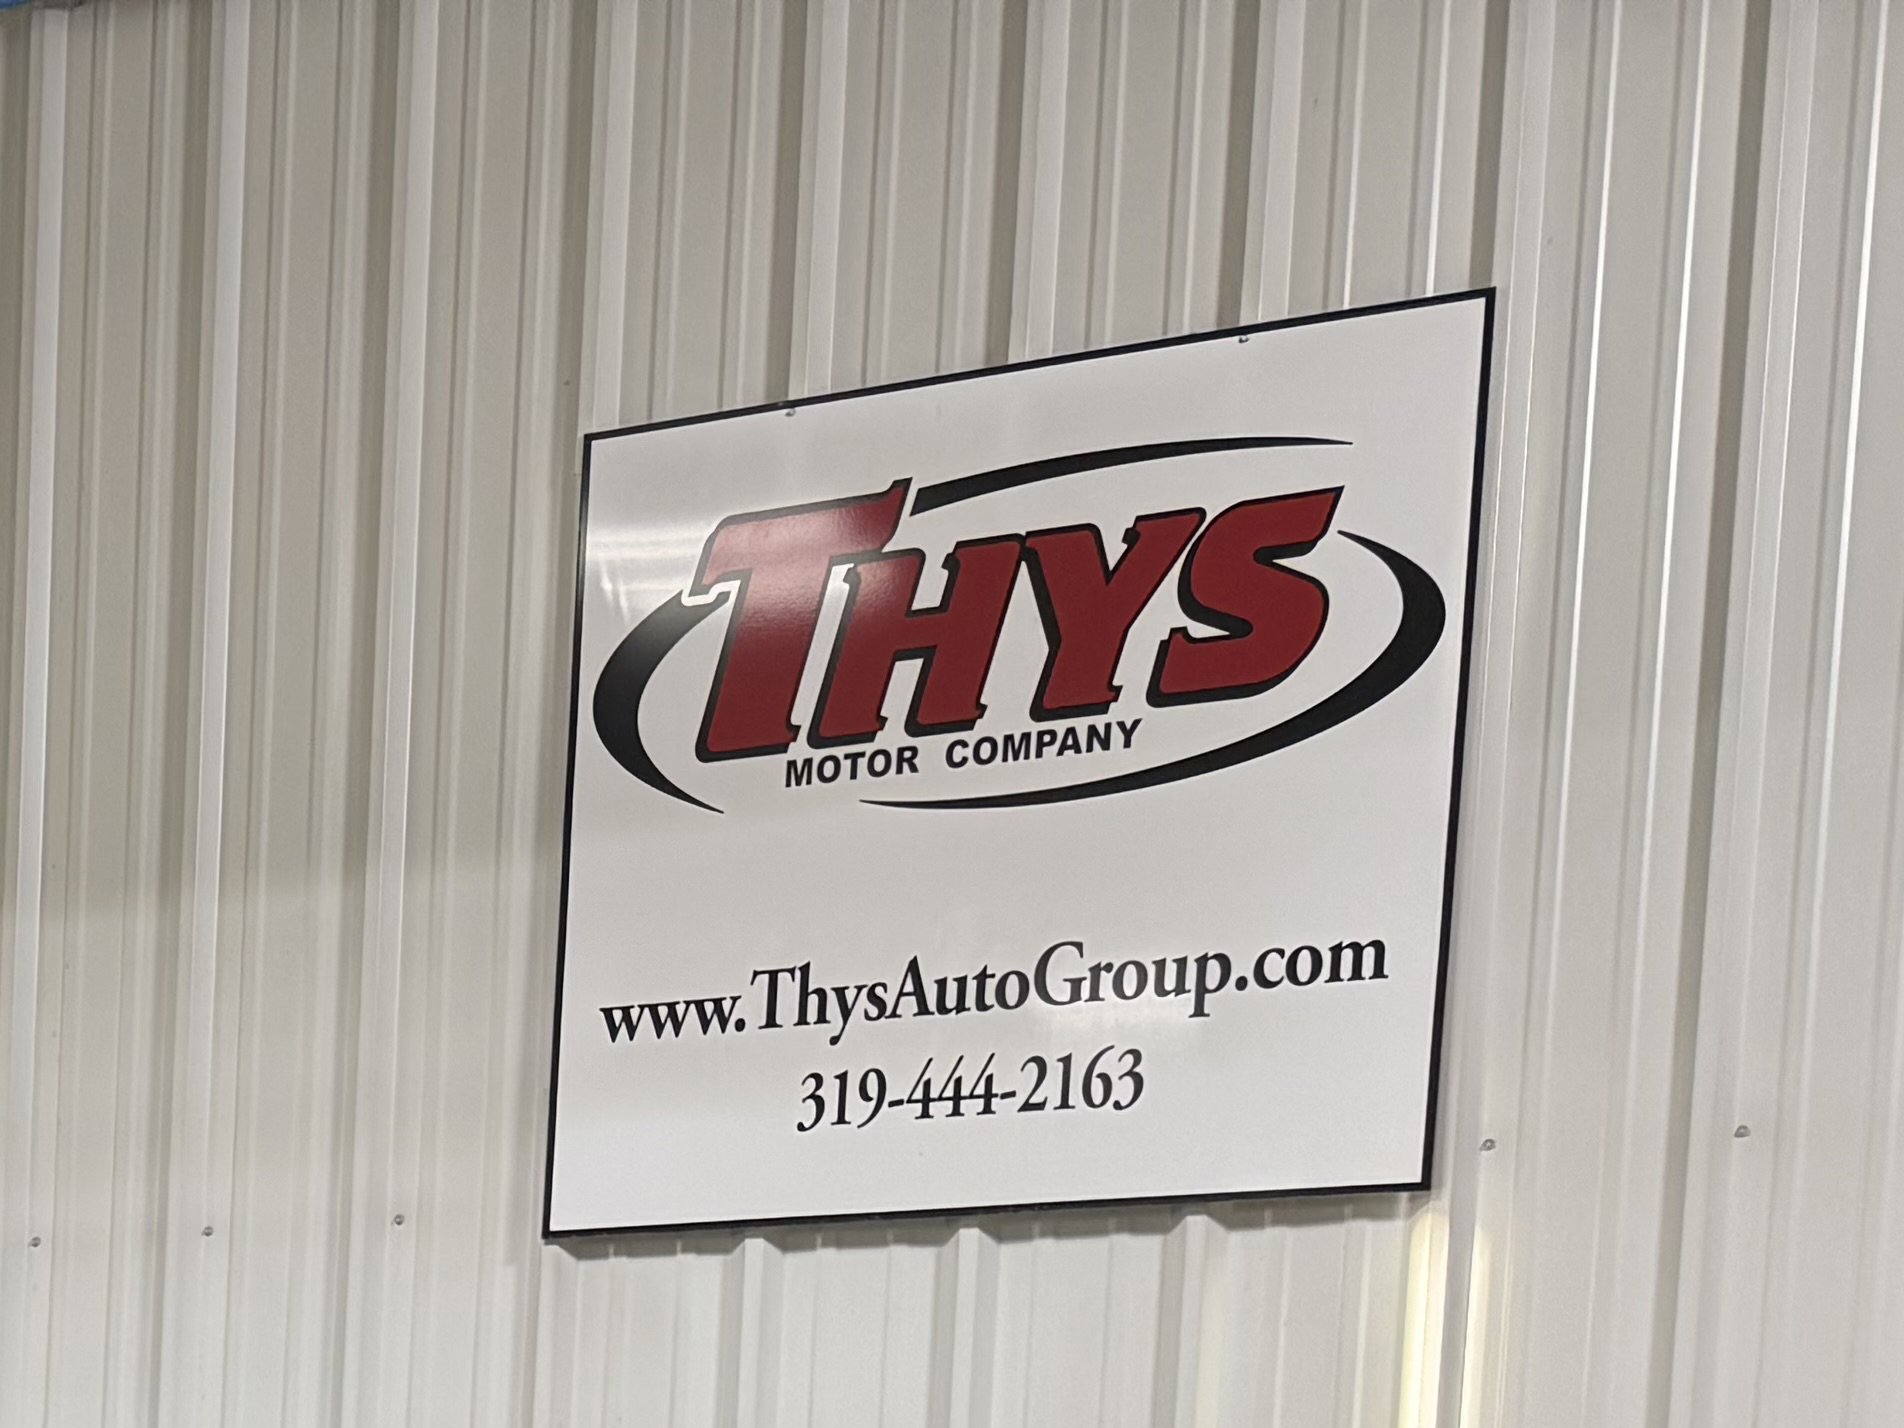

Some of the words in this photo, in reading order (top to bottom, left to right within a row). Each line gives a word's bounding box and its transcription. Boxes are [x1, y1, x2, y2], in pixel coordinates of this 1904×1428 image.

[681, 477, 1345, 764] THYS
[785, 744, 920, 788] MOTOR
[945, 718, 1143, 769] COMPANY
[599, 936, 1390, 1045] www.ThysAutoGroup.com
[797, 1044, 1145, 1133] 319-444-2163
